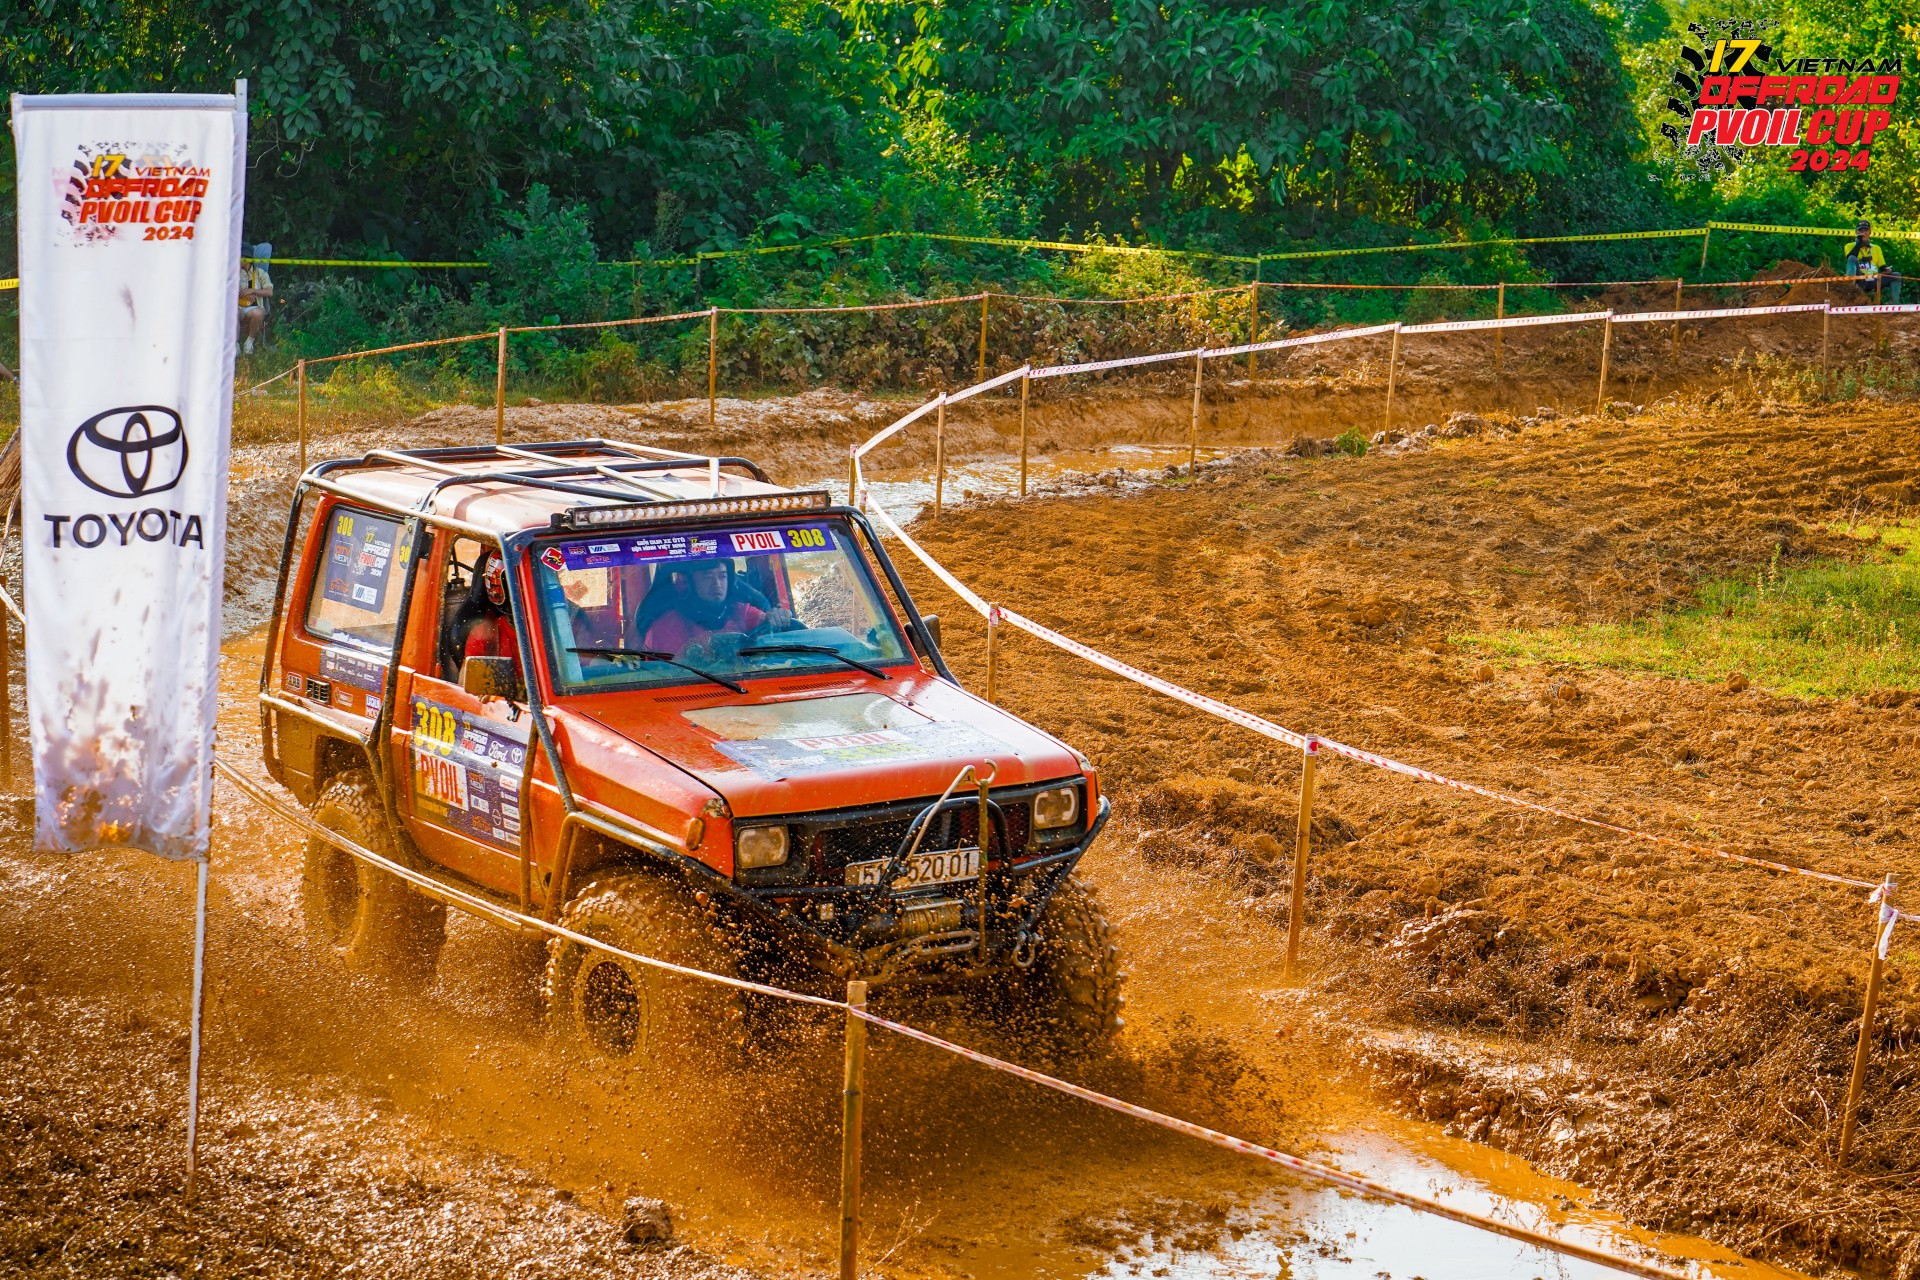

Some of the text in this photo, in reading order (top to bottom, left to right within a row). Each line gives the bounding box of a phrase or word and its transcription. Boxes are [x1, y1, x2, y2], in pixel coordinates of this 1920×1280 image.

[92, 153, 126, 177] 17
[135, 167, 211, 177] VIETNAM
[84, 178, 209, 198] OFFROAD
[79, 200, 203, 223] PVOIL CUP
[143, 226, 195, 241] 2024
[44, 508, 204, 550] TOYOTA
[337, 515, 354, 537] 308
[735, 532, 781, 551] PVOIL
[787, 528, 826, 548] 308
[414, 701, 457, 756] 308
[488, 740, 507, 762] Ford
[798, 732, 892, 749] PVOIL
[420, 753, 463, 806] PVOIL
